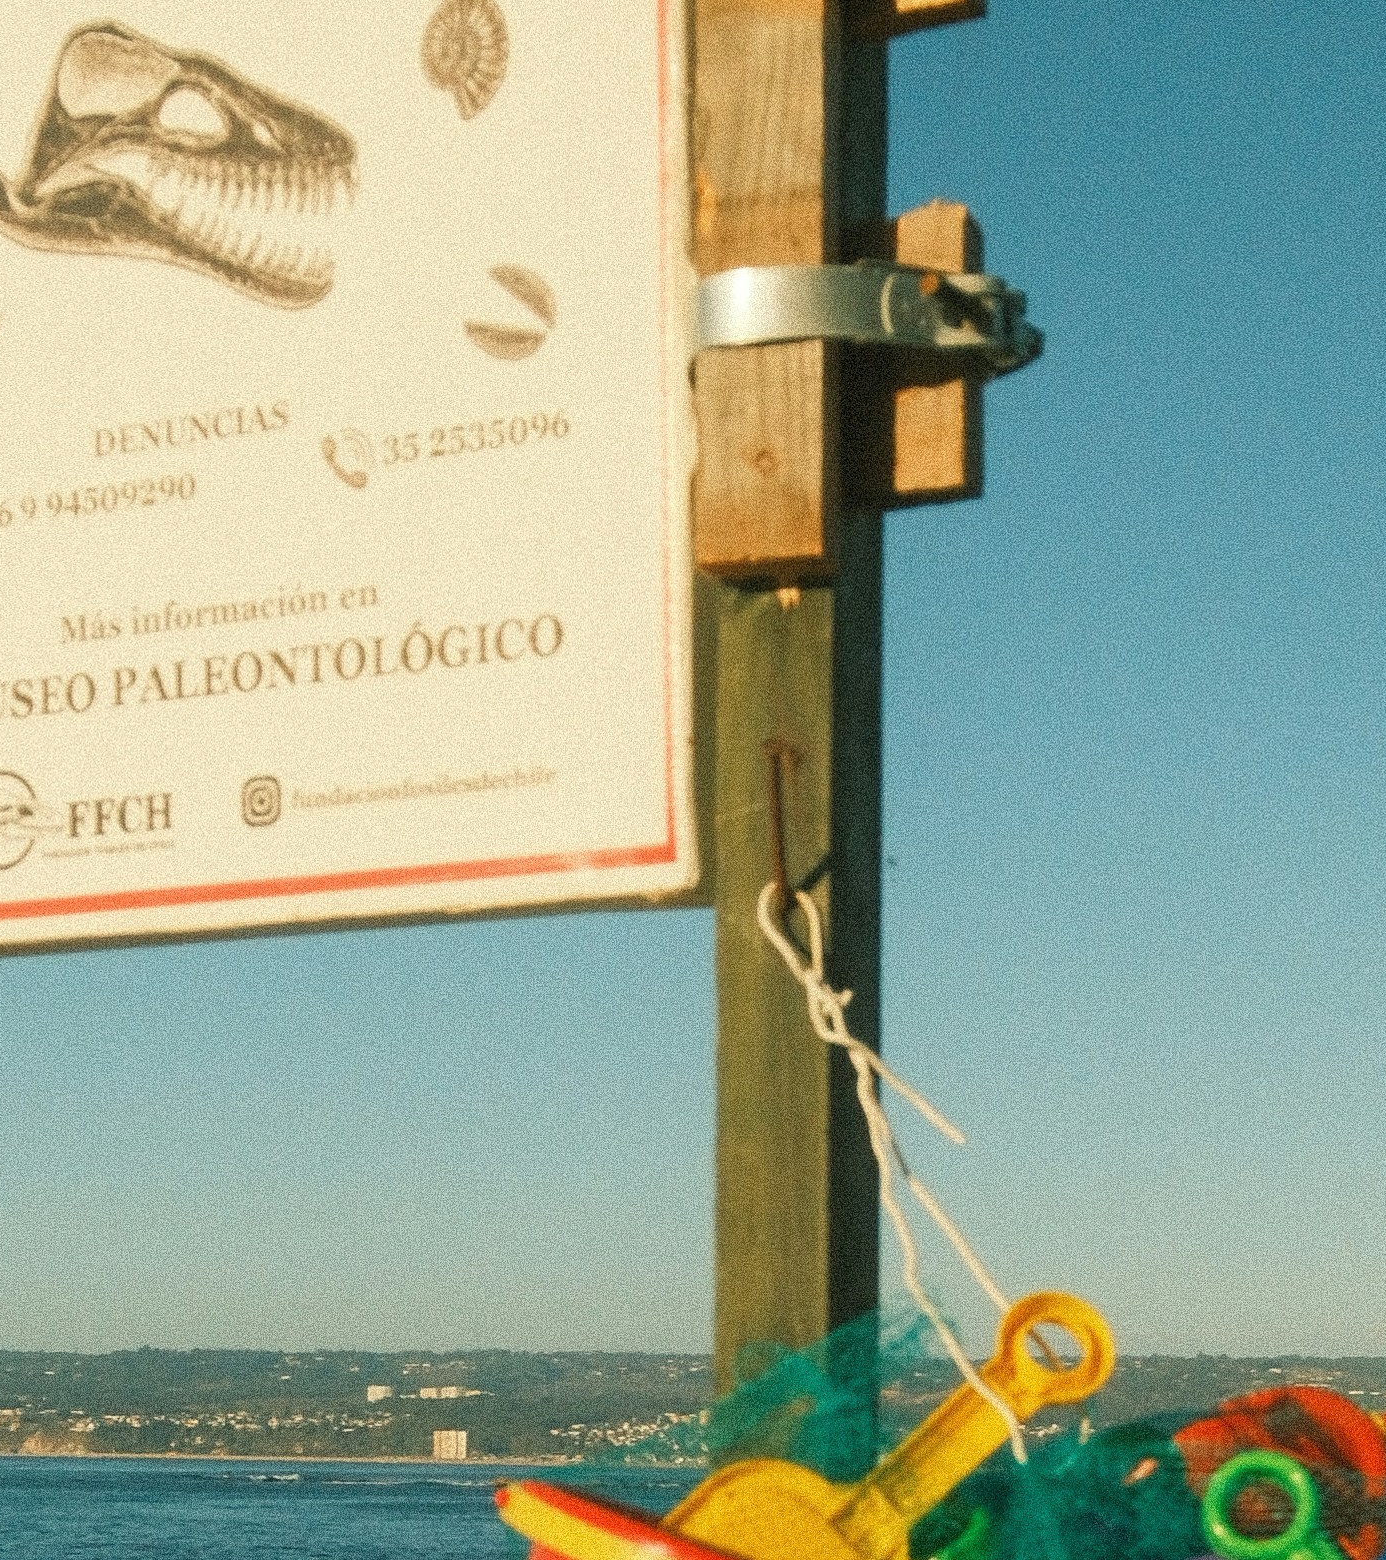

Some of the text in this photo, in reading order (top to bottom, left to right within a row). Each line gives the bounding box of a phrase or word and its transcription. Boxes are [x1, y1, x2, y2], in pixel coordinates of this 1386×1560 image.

[93, 401, 291, 457] DENUNCIAS
[383, 410, 572, 466] 35 2535096
[19, 494, 38, 519] 9
[44, 473, 198, 518] 94509290
[60, 582, 380, 644] Más información en
[111, 613, 567, 708] PALEONTOLÓGICO
[66, 790, 173, 839] FFCH
